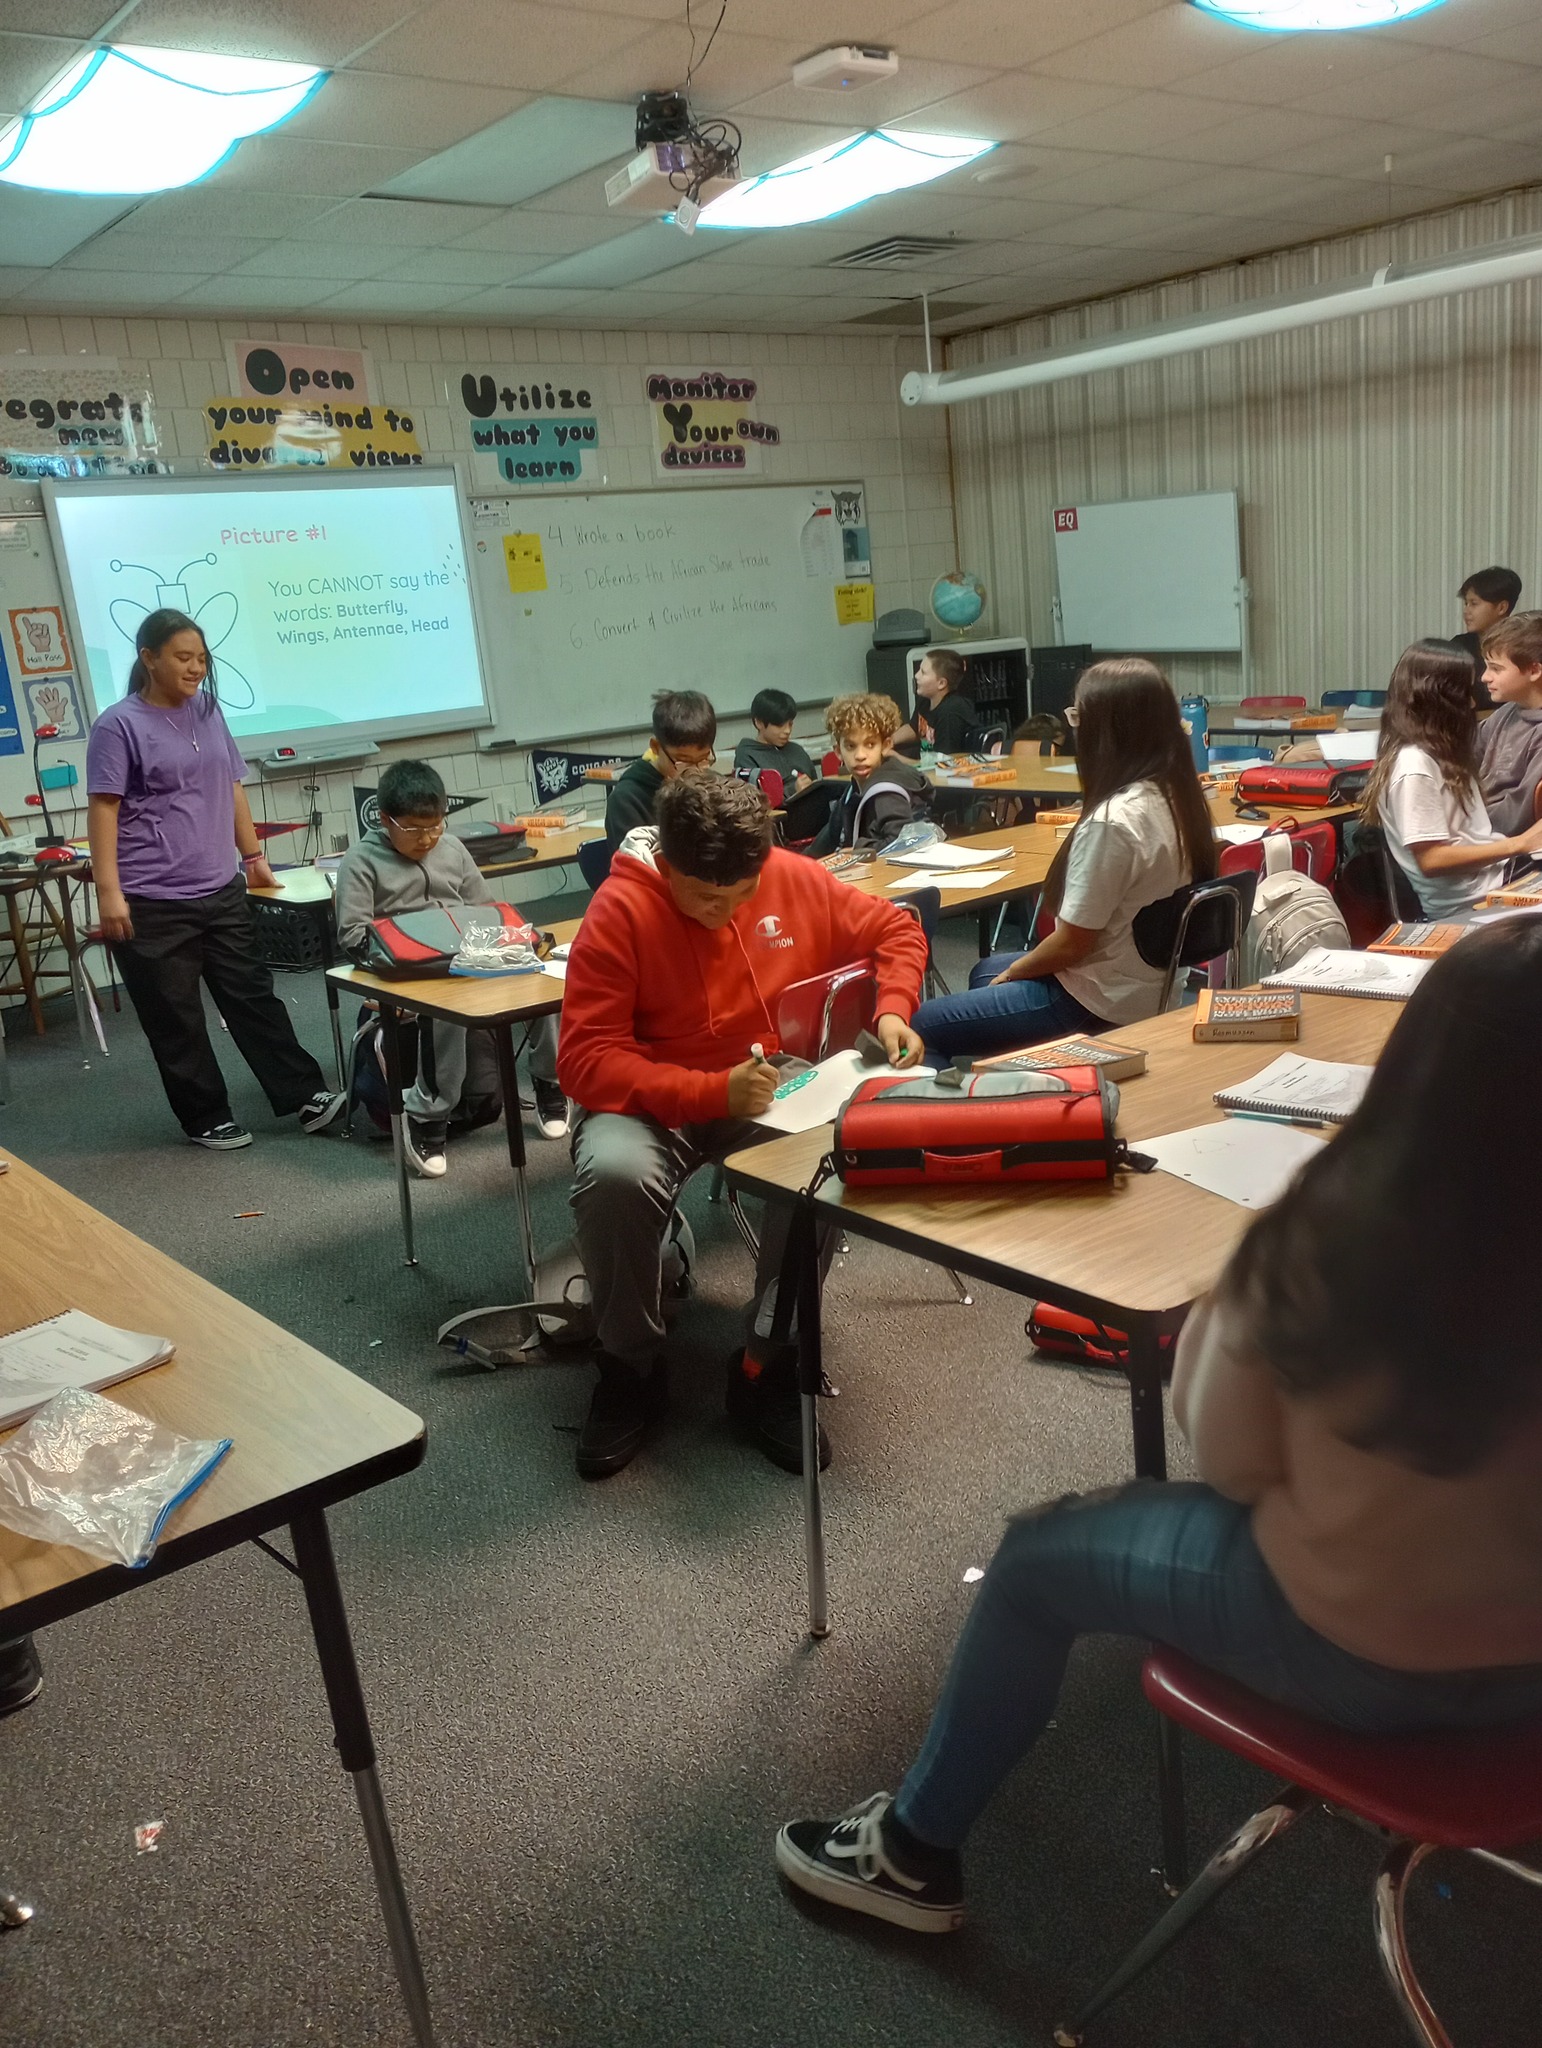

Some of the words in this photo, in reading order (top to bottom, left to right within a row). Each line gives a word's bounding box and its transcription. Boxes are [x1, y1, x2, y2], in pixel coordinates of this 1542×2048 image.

[245, 348, 355, 395] Open
[461, 373, 592, 418] Utilize
[648, 375, 755, 400] Monitor
[0, 392, 143, 429] egrate
[207, 407, 283, 431] your
[384, 409, 414, 433] to
[663, 403, 734, 443] Your
[737, 421, 779, 442] own
[473, 423, 541, 446] what
[553, 426, 596, 447] you
[664, 441, 745, 466] devices
[504, 457, 576, 480] learn
[615, 532, 626, 542] a
[634, 519, 677, 541] book
[1058, 512, 1074, 529] EQ
[220, 527, 299, 546] Picture
[305, 524, 327, 541] #1
[585, 564, 640, 591] Defends
[644, 562, 665, 584] the
[739, 547, 772, 568] trade
[268, 580, 302, 597] You
[307, 574, 384, 595] CANNOT
[389, 576, 419, 591] say
[423, 570, 450, 587] the
[273, 604, 333, 623] words:
[336, 599, 409, 618] Butterfly,
[593, 617, 640, 640] Convert
[732, 593, 778, 613] Africans
[277, 629, 329, 646] Wings,
[333, 622, 408, 640] Antennae,
[411, 616, 450, 633] Head
